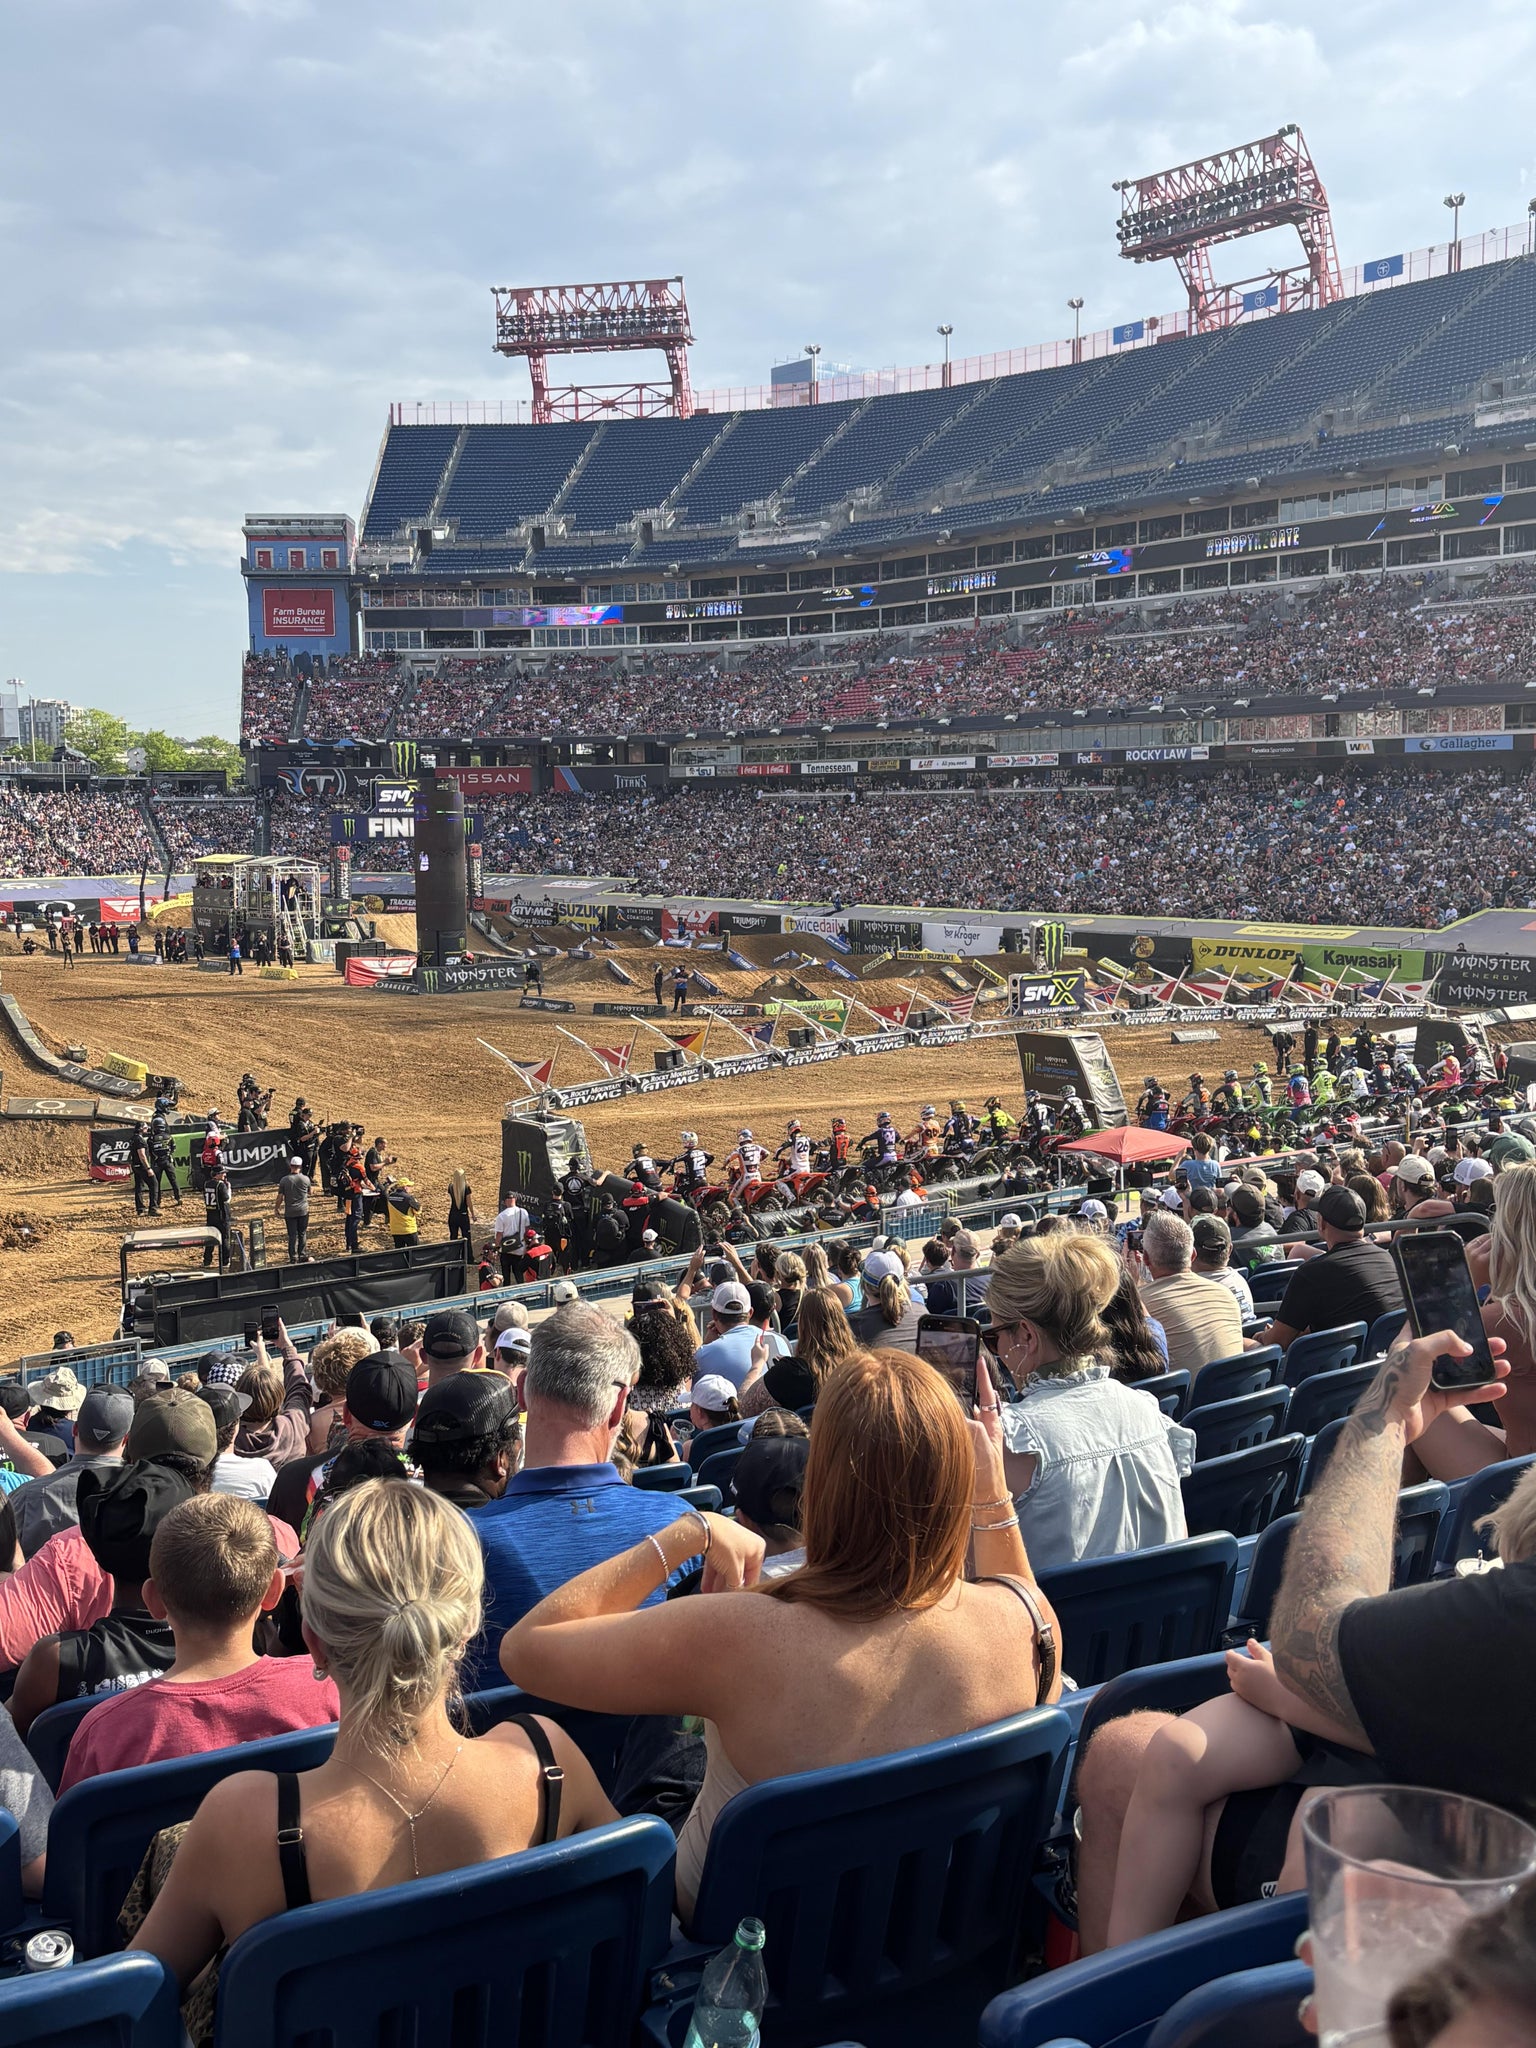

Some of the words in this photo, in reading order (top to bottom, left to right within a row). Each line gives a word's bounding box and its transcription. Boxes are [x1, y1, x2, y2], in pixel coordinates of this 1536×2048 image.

[273, 607, 294, 616] Farm
[297, 607, 325, 616] Bureau
[273, 616, 325, 625] INSURANCE
[1440, 737, 1497, 750] Gallagher
[1077, 752, 1102, 764] FedEx
[1126, 750, 1161, 761] ROCKY
[1163, 748, 1187, 760] LAW
[449, 773, 520, 784] NISSAN
[864, 920, 906, 933] MONSTER
[954, 929, 980, 946] Kroger
[1214, 945, 1295, 961] DUNLOP
[1324, 950, 1402, 969] Kawasaki
[1452, 955, 1532, 973] MONSTER
[445, 967, 517, 984] MONSTER
[1462, 972, 1519, 981] ENERGY
[1023, 976, 1079, 1006] SMX
[1449, 984, 1528, 1002] MONSTER
[1023, 1007, 1041, 1016] WORLD
[796, 1049, 812, 1057] ROCKY
[650, 1073, 669, 1084] ROCKY
[669, 1067, 700, 1080] MOUNTAIN
[570, 1088, 589, 1098] ROCKY
[590, 1082, 621, 1095] MOUNTAIN
[797, 1140, 809, 1154] 26
[693, 1156, 706, 1171] 12
[204, 1192, 217, 1206] 12
